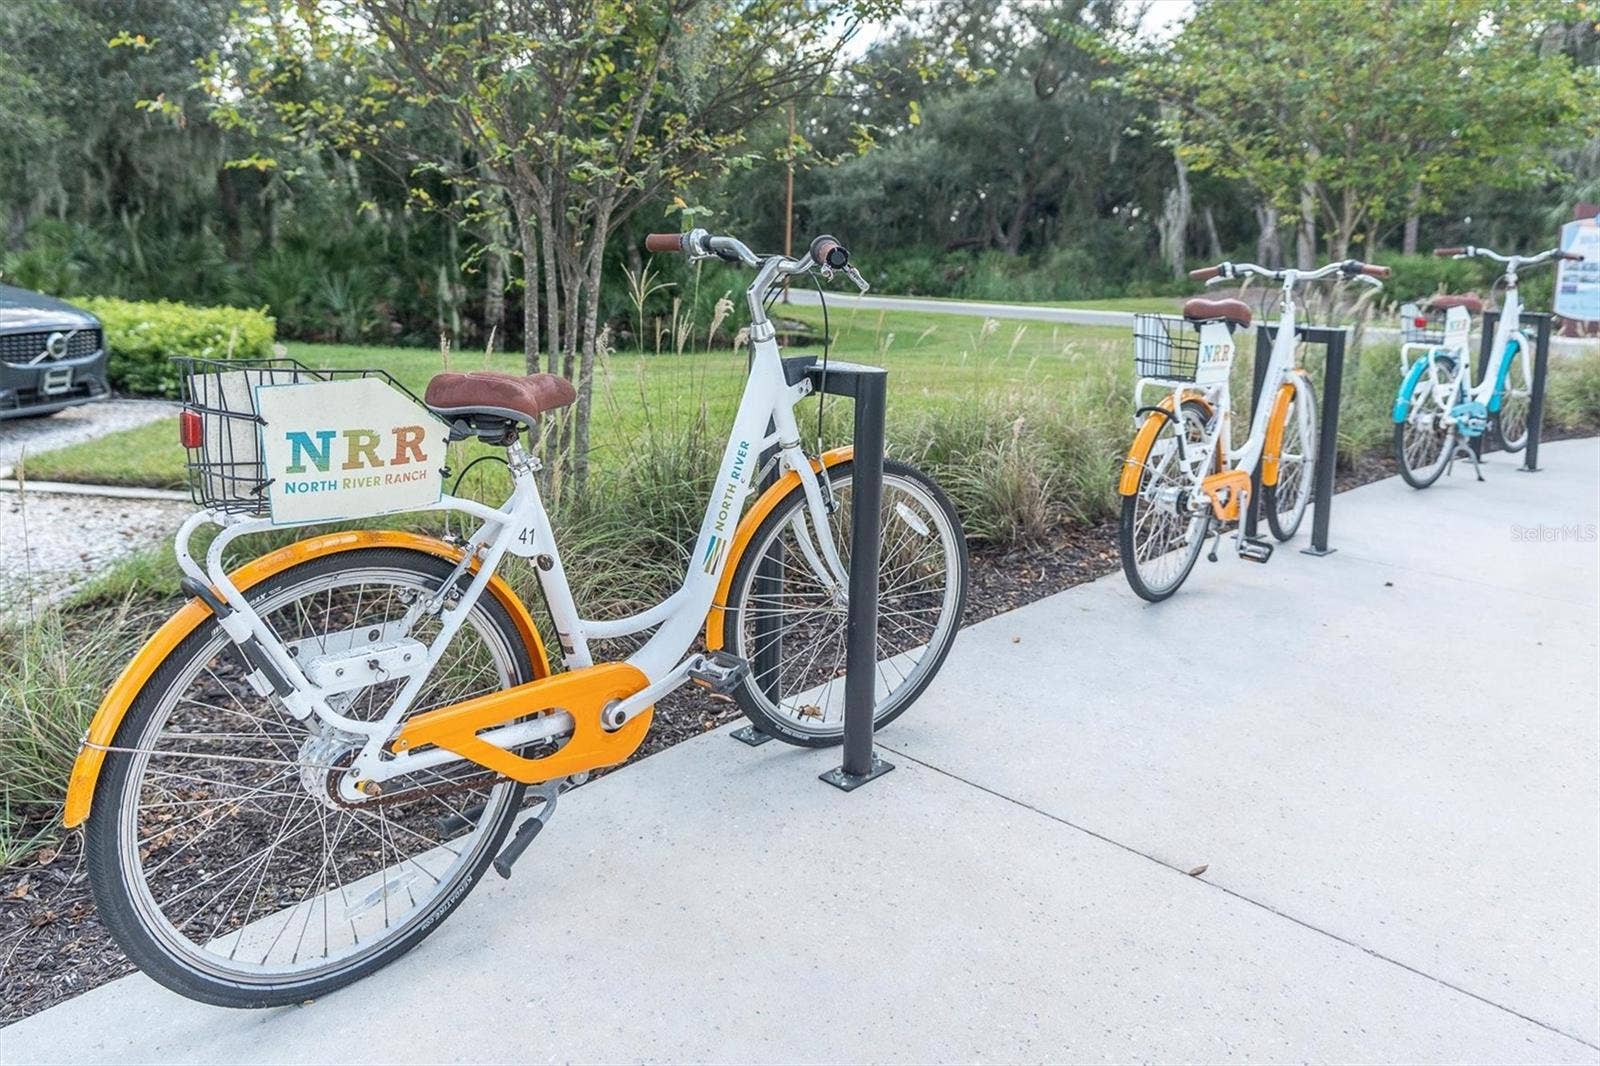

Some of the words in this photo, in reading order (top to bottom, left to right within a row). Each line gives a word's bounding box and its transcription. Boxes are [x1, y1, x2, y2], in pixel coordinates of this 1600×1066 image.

[1202, 344, 1230, 363] NRR
[286, 424, 428, 474] NRR
[285, 480, 338, 494] NORTH
[342, 476, 381, 490] RIVER
[384, 470, 428, 485] RANCH
[715, 483, 737, 532] NORTH
[731, 440, 750, 480] RIVER
[518, 527, 535, 545] 41
